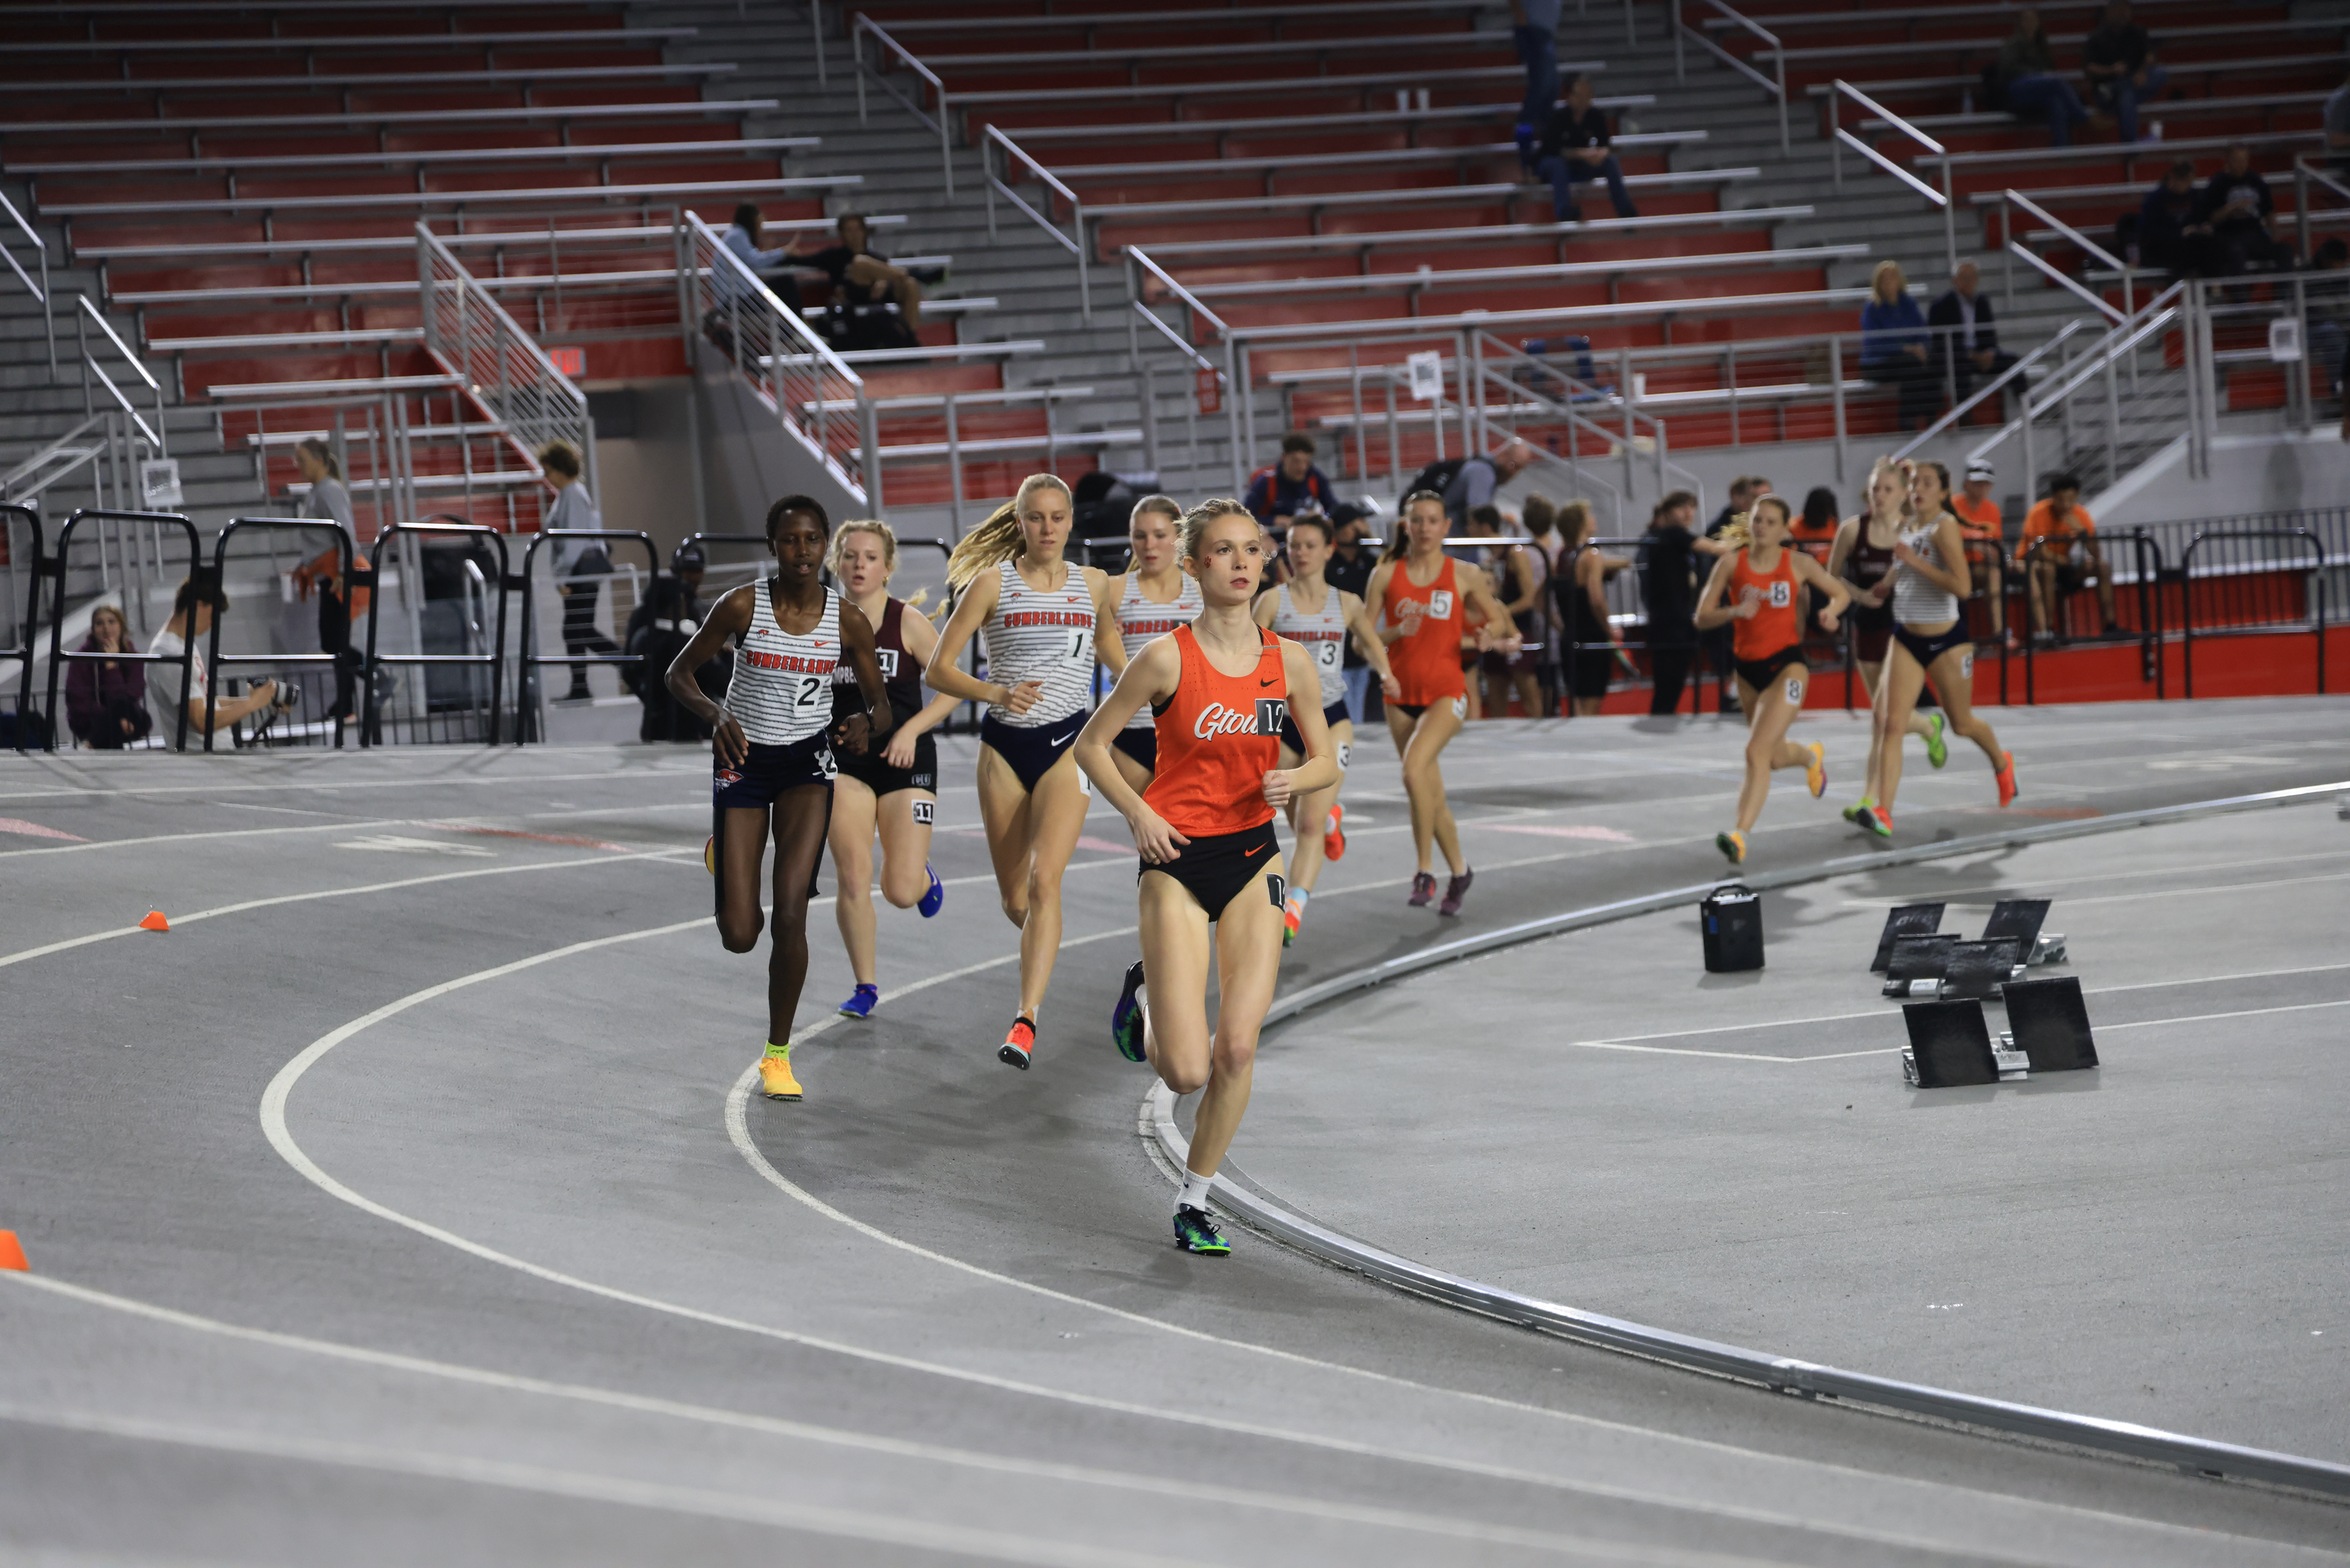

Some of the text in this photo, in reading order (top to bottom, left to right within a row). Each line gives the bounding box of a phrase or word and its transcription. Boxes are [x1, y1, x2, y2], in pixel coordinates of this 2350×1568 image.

[1434, 591, 1448, 615] 5
[1774, 583, 1786, 602] 8
[1004, 611, 1092, 628] CUMBERLANDS
[1072, 633, 1084, 658] 1
[1322, 643, 1336, 665] 3
[746, 650, 837, 674] CUMBERLANDS
[797, 678, 820, 706] 2
[1789, 680, 1800, 700] 8
[1265, 703, 1284, 732] 12
[916, 804, 933, 822] 11
